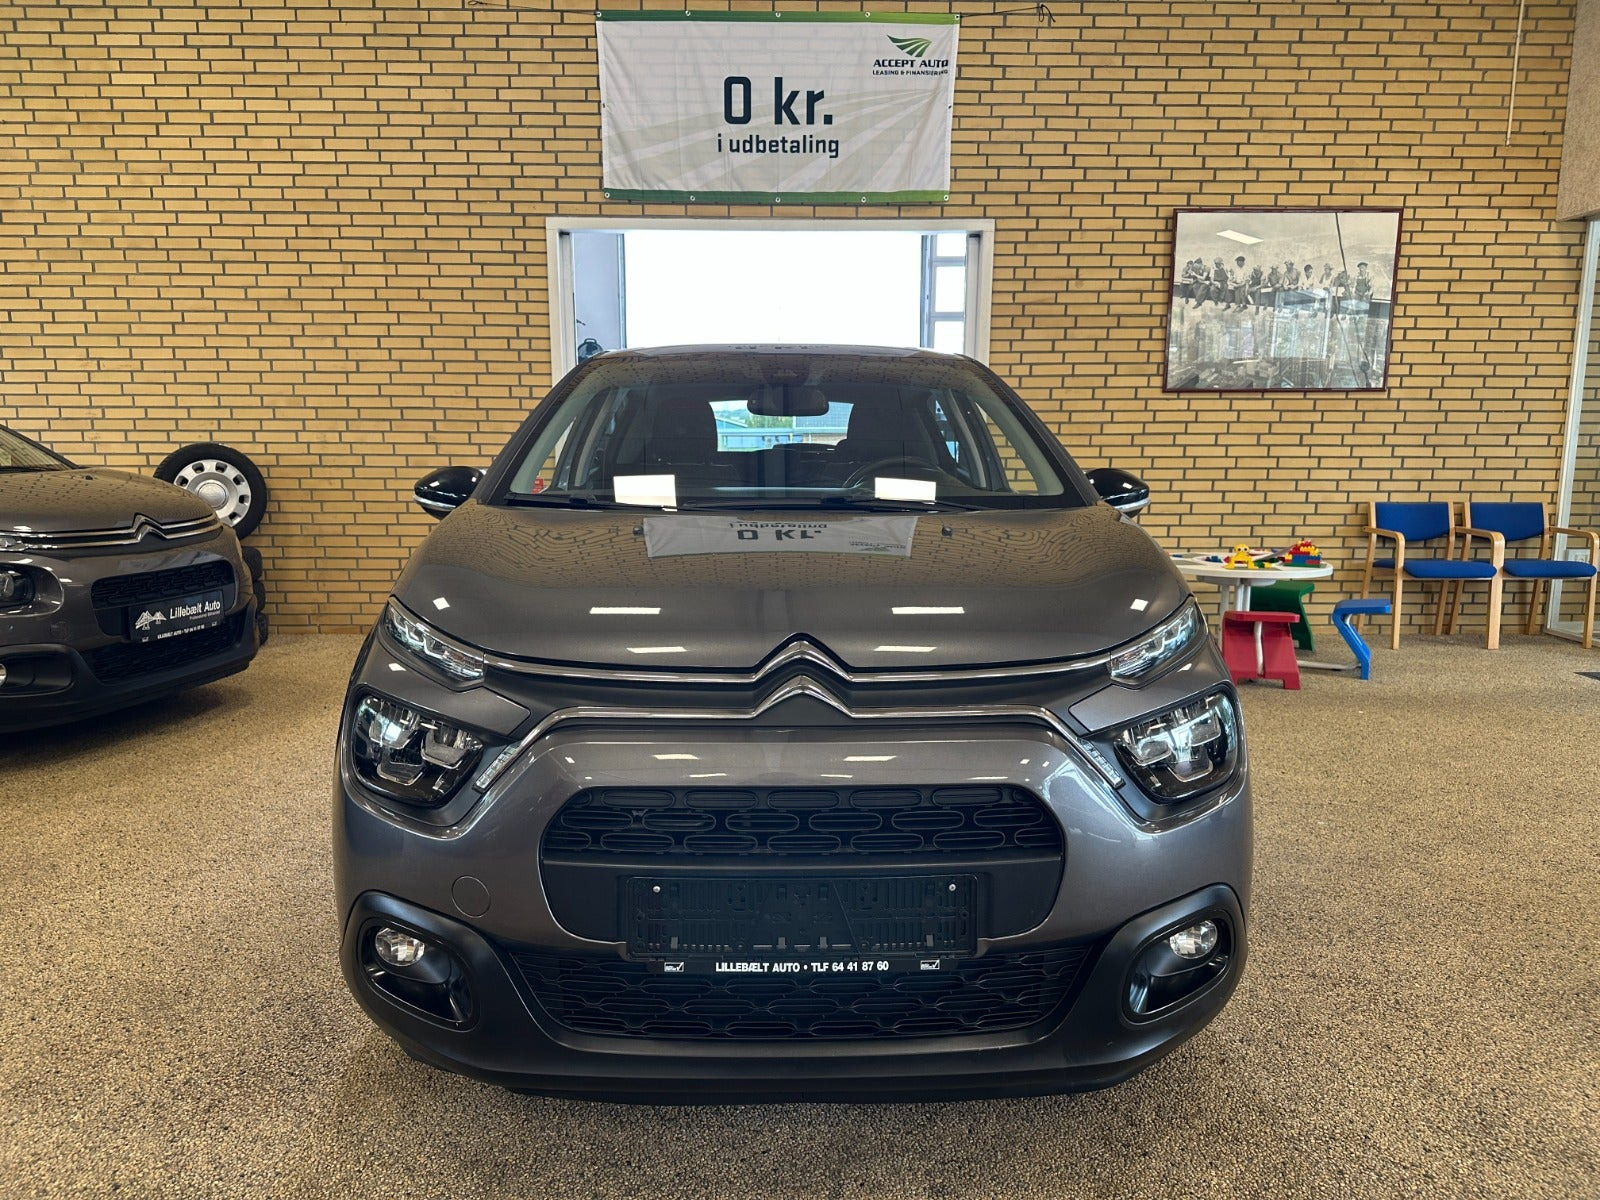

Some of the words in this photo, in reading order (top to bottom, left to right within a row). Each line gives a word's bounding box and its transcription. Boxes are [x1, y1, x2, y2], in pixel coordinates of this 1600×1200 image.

[873, 59, 916, 68] ACCEPT
[919, 59, 949, 68] AUTO
[905, 69, 949, 77] FINANSIERING
[774, 76, 833, 125] kr.
[717, 133, 722, 153] i
[729, 134, 839, 158] udbetaling
[170, 603, 202, 619] Lillebælt
[204, 600, 221, 612] Auto
[715, 962, 770, 973] LILLEBÆLT
[772, 962, 800, 973] AUTO
[811, 962, 829, 973] TLF
[831, 961, 844, 972] 64
[847, 961, 858, 972] 41
[861, 961, 874, 972] 87
[876, 960, 889, 971] 60
